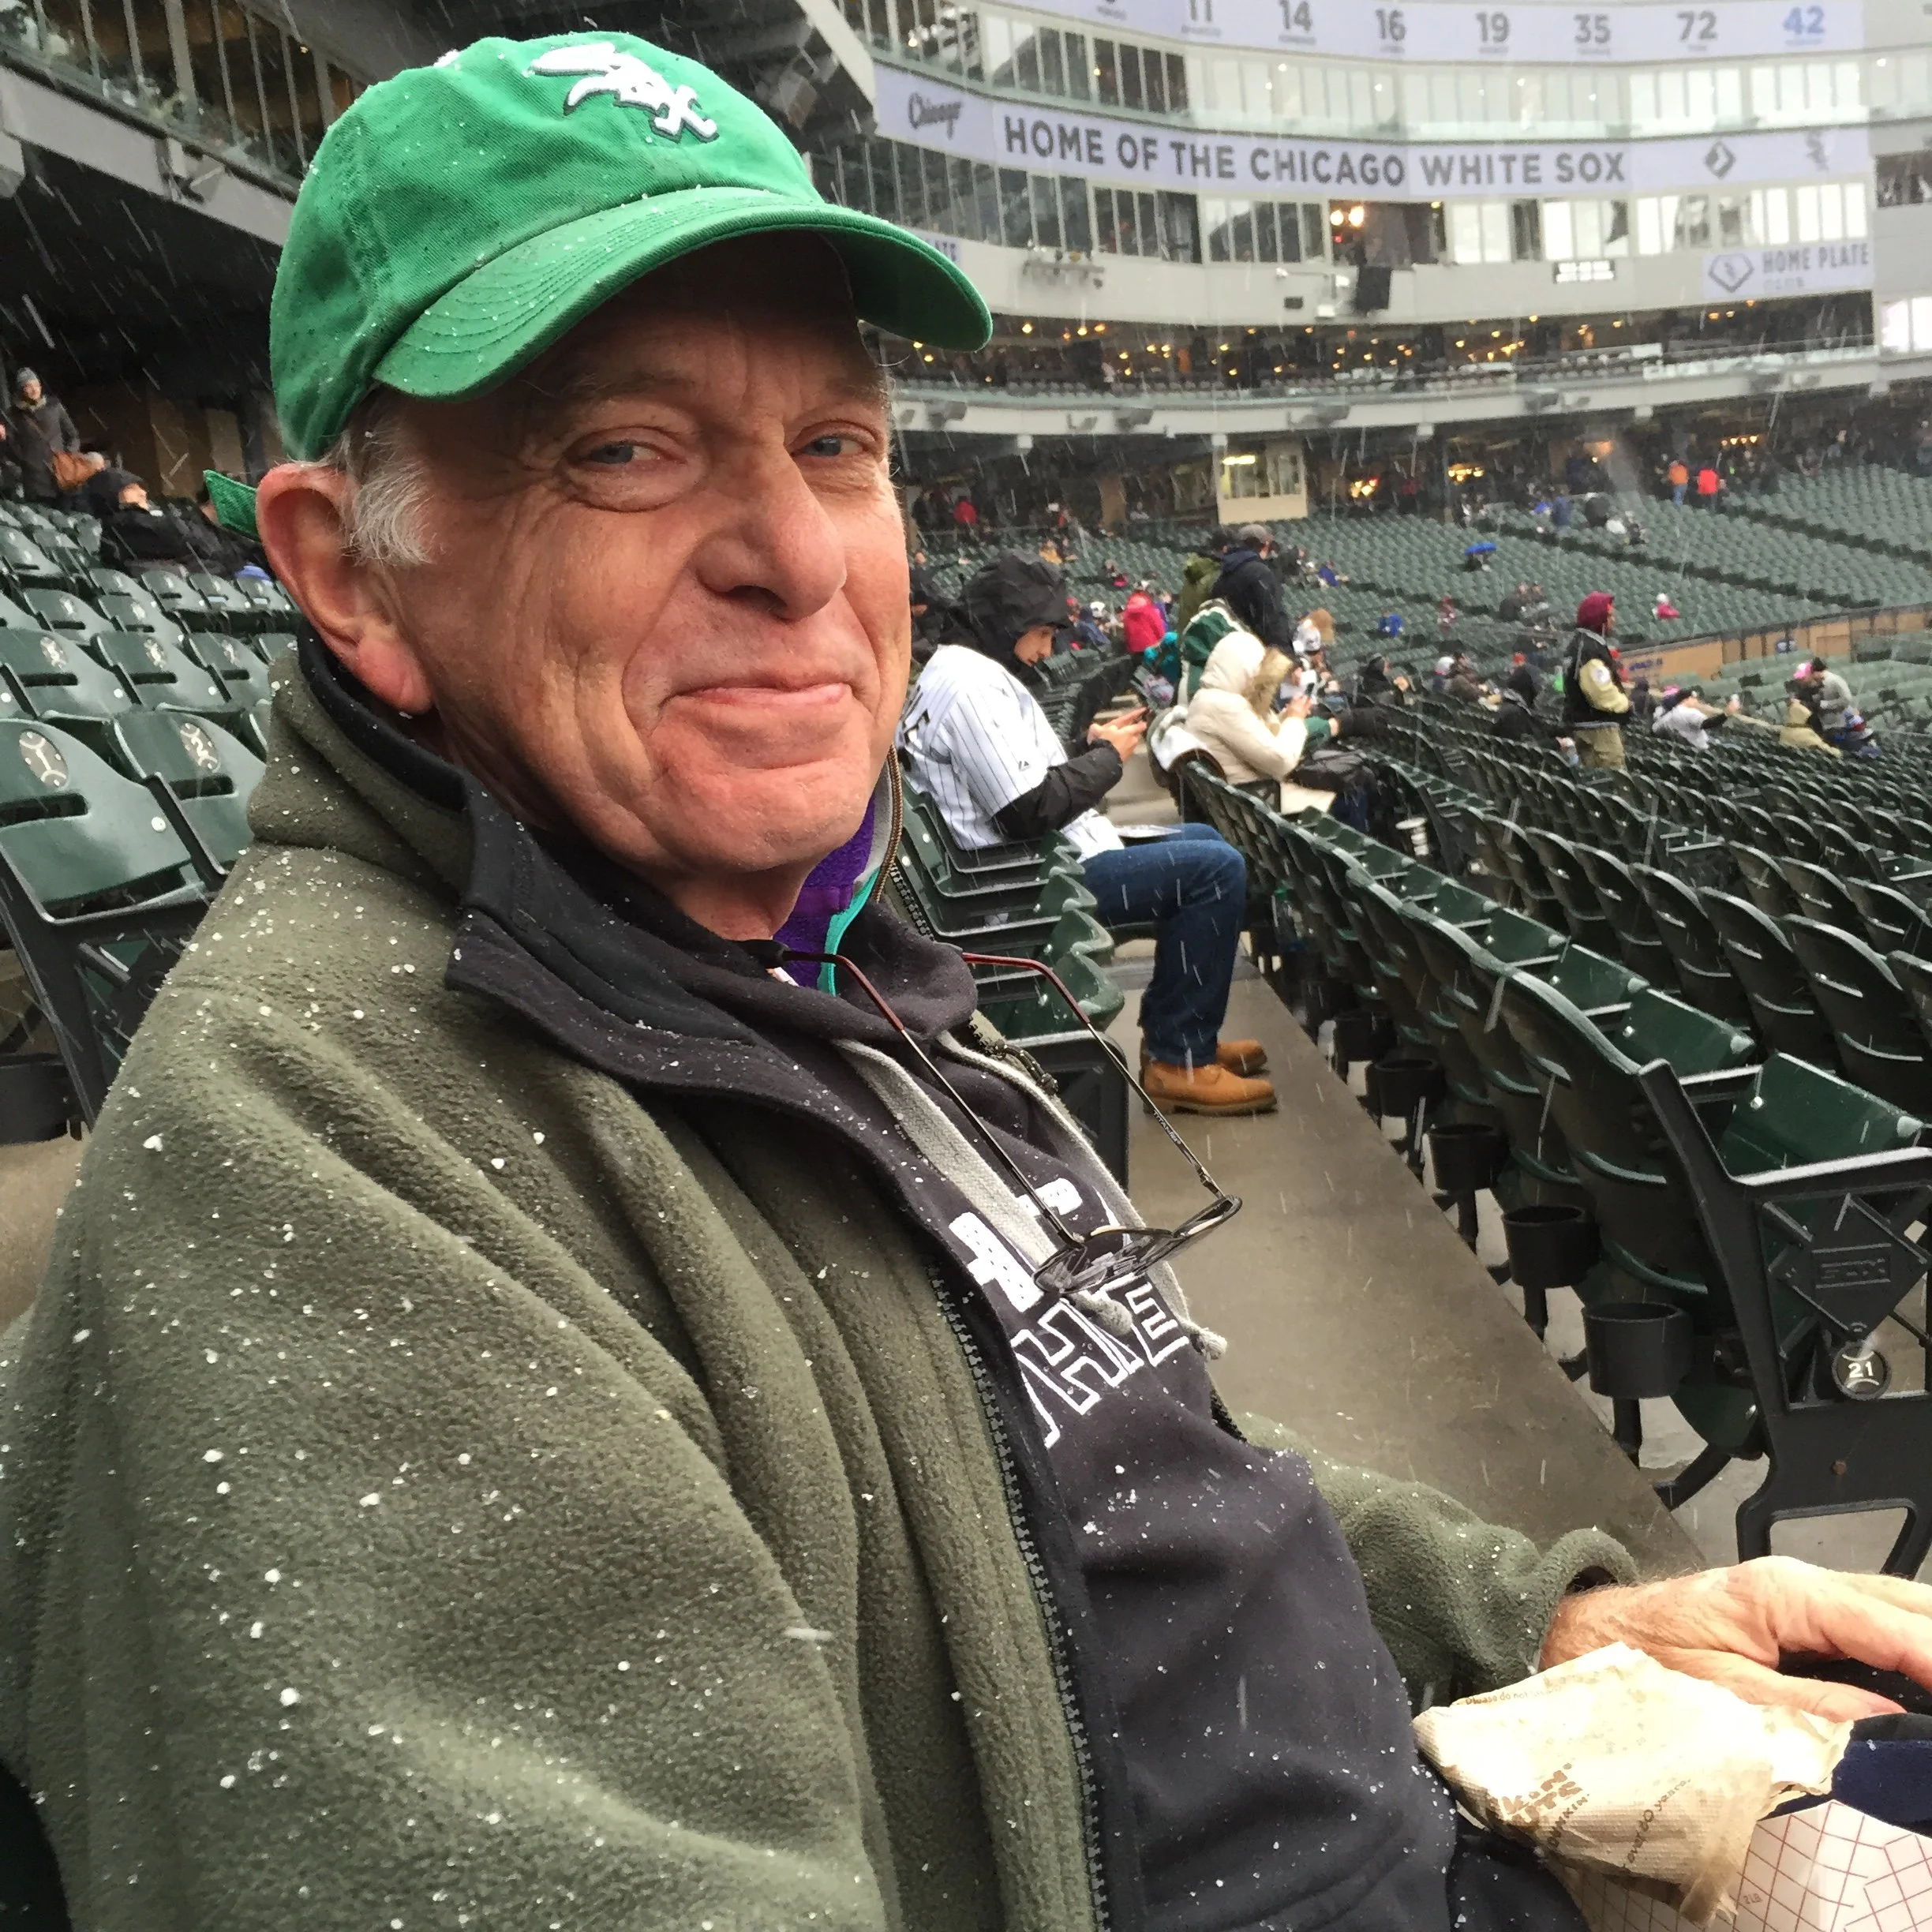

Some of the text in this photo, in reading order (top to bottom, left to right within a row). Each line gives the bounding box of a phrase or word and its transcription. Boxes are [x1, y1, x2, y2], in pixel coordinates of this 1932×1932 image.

[1279, 0, 1314, 32] 14
[1375, 8, 1406, 42] 16
[1474, 10, 1511, 43] 19
[1574, 13, 1612, 44] 35
[1676, 9, 1719, 43] 72
[1782, 6, 1825, 35] 42
[1004, 115, 1626, 187] HOME OF THE CHICAGO WHITE SOX
[1762, 242, 1869, 274] HOME PLATE
[1848, 1361, 1874, 1379] 21
[1500, 1692, 1511, 1701] do
[1514, 1691, 1530, 1700] not
